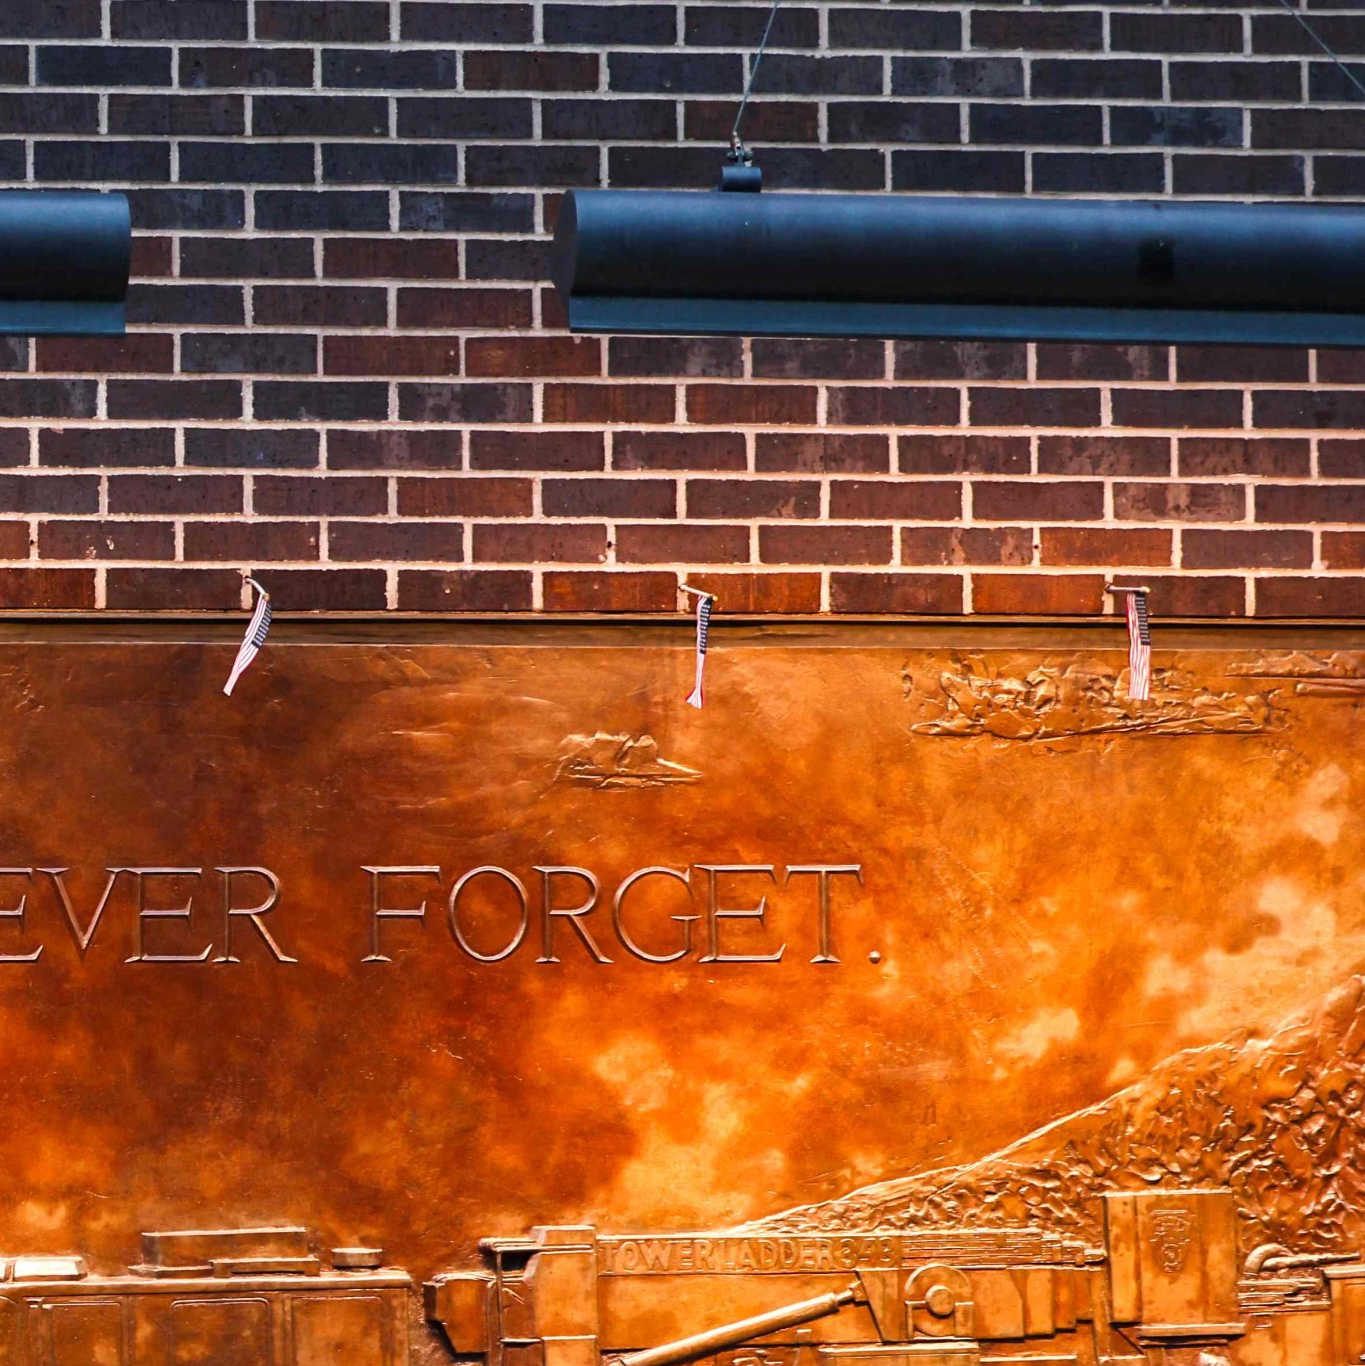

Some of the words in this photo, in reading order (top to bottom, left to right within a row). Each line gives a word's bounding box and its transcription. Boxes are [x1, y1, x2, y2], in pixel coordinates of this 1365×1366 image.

[363, 862, 882, 967] FORGET.
[599, 1238, 716, 1272] TOWER
[719, 1237, 835, 1271] LADDER
